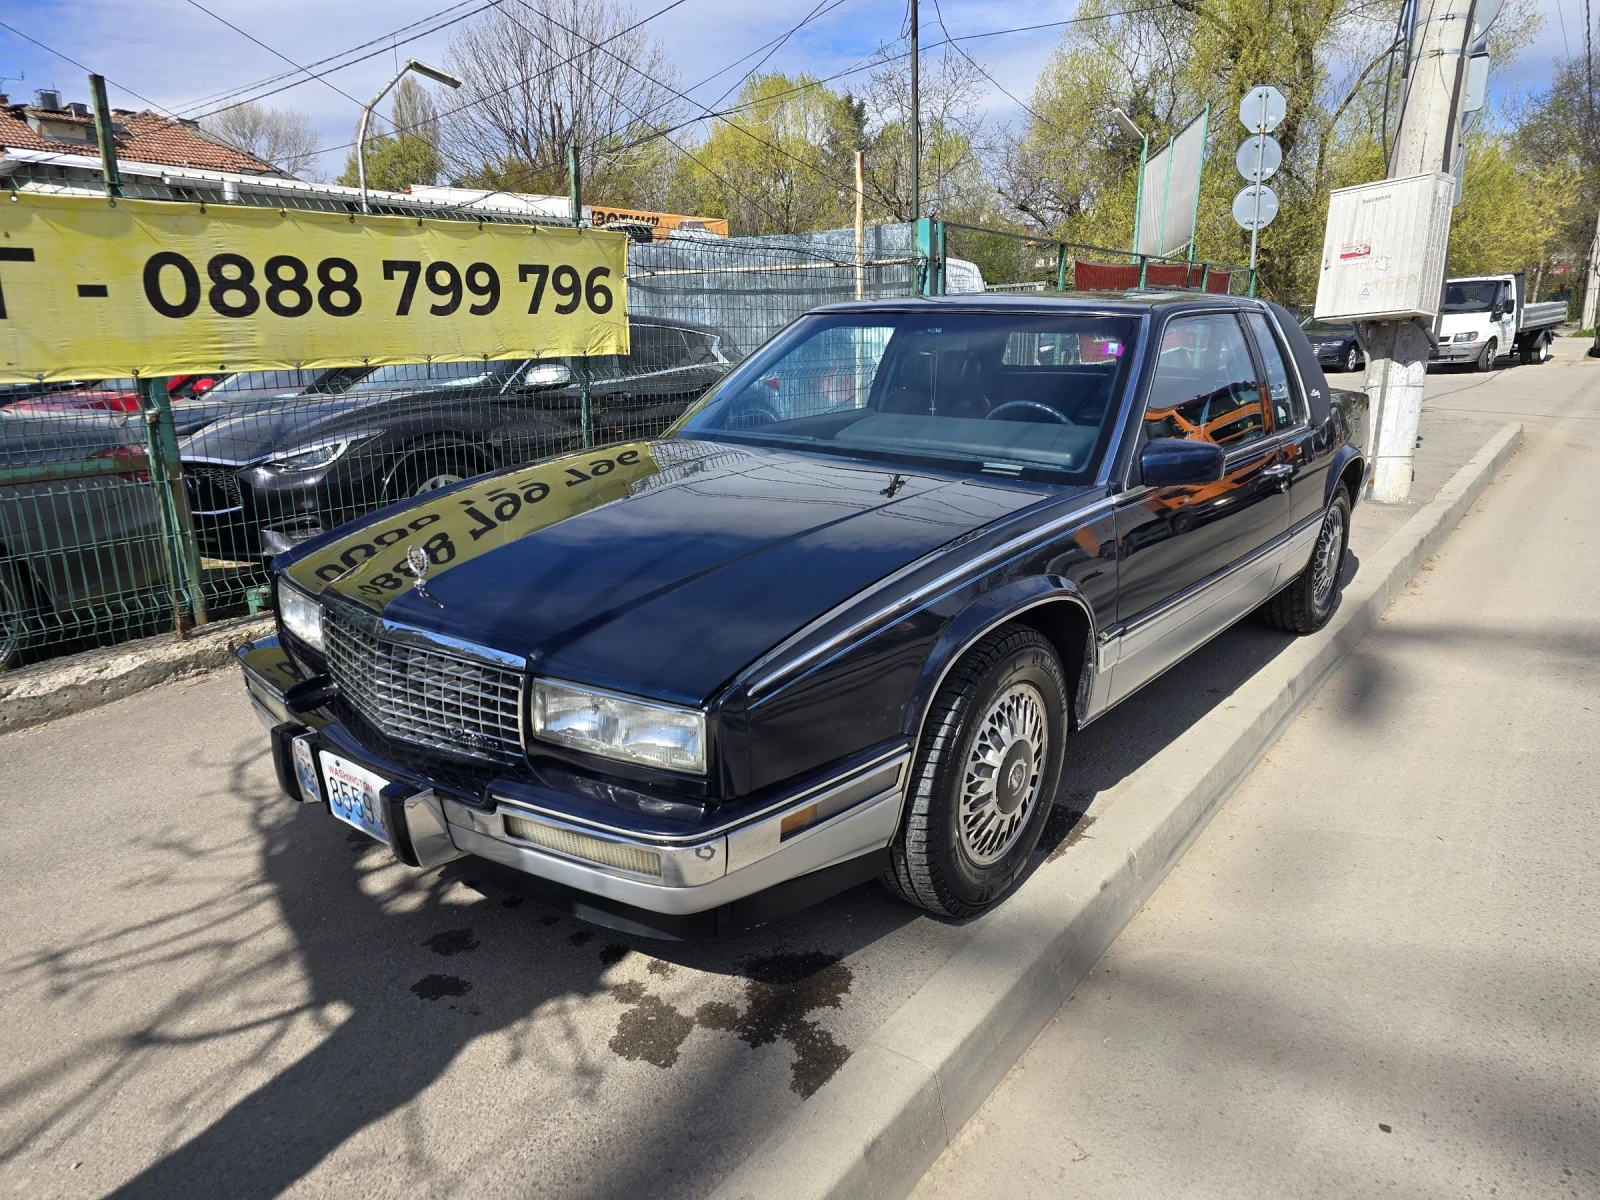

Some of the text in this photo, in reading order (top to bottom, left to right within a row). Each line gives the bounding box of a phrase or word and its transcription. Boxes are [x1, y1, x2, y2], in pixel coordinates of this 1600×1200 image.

[143, 251, 363, 319] 0888
[382, 260, 501, 317] 799
[518, 264, 614, 315] 796
[327, 764, 374, 794] WASHINGTON
[329, 776, 375, 825] 8559
